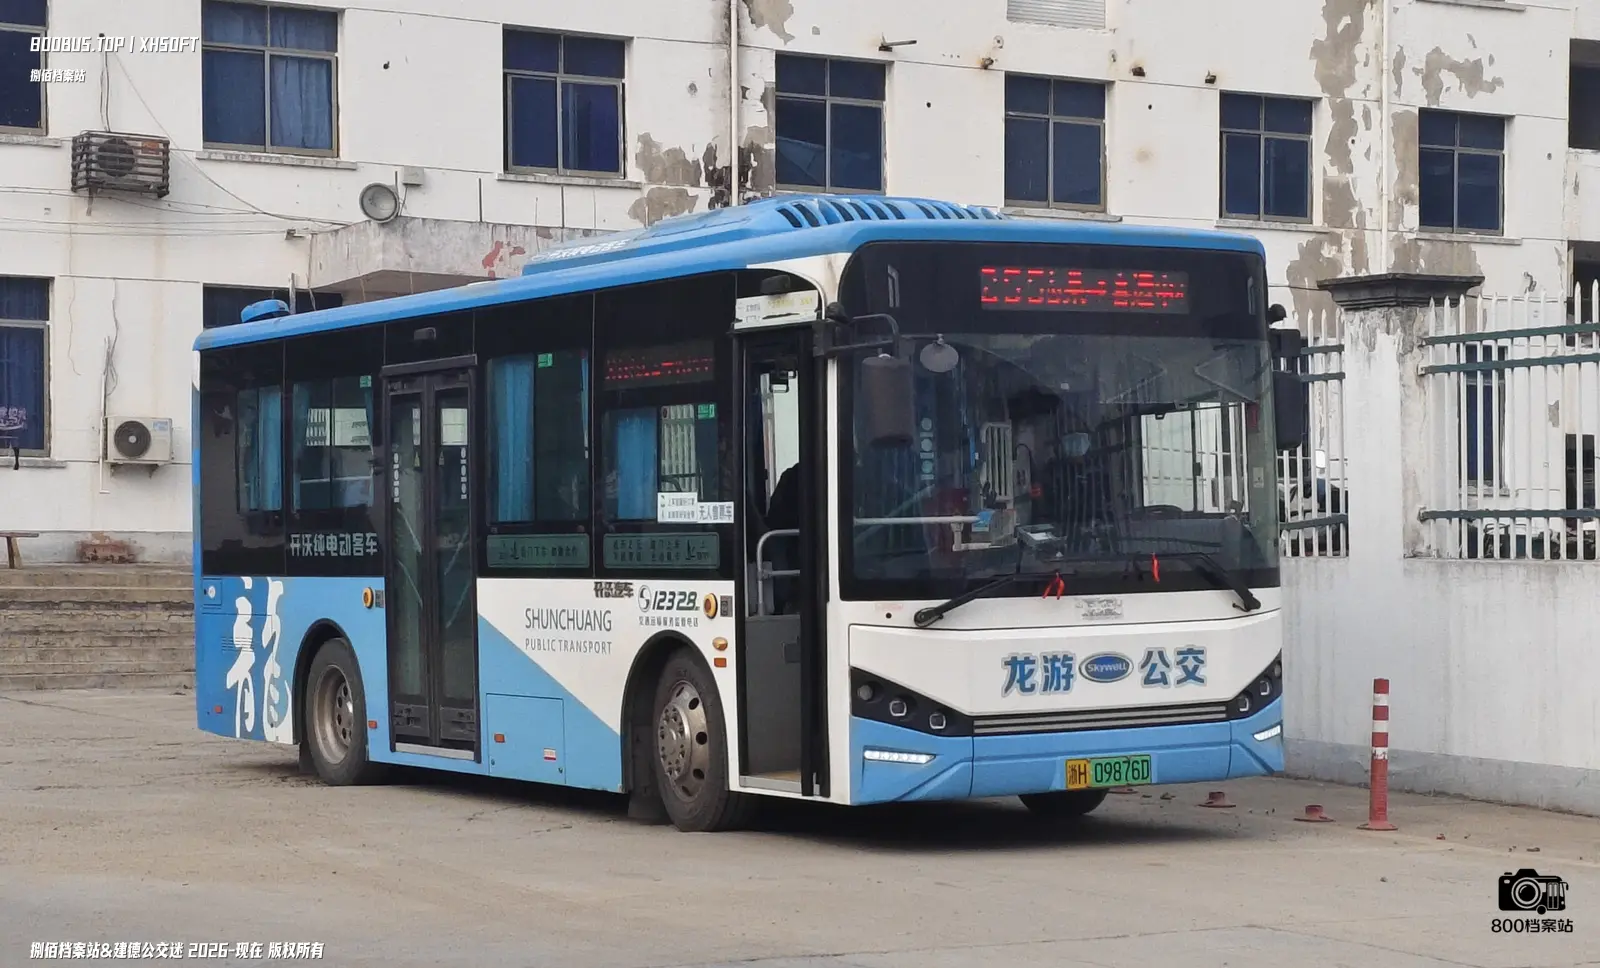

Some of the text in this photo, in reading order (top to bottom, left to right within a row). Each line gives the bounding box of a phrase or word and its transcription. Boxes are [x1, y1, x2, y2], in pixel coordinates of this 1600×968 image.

[290, 532, 378, 557] 开沃纯电动客车
[652, 590, 700, 611] 12328
[525, 607, 612, 632] SHUNCHUANG
[525, 638, 613, 655] PUBLIC TRANSPORT
[1002, 645, 1207, 696] 龙游 公交
[1093, 758, 1150, 784] 09876D
